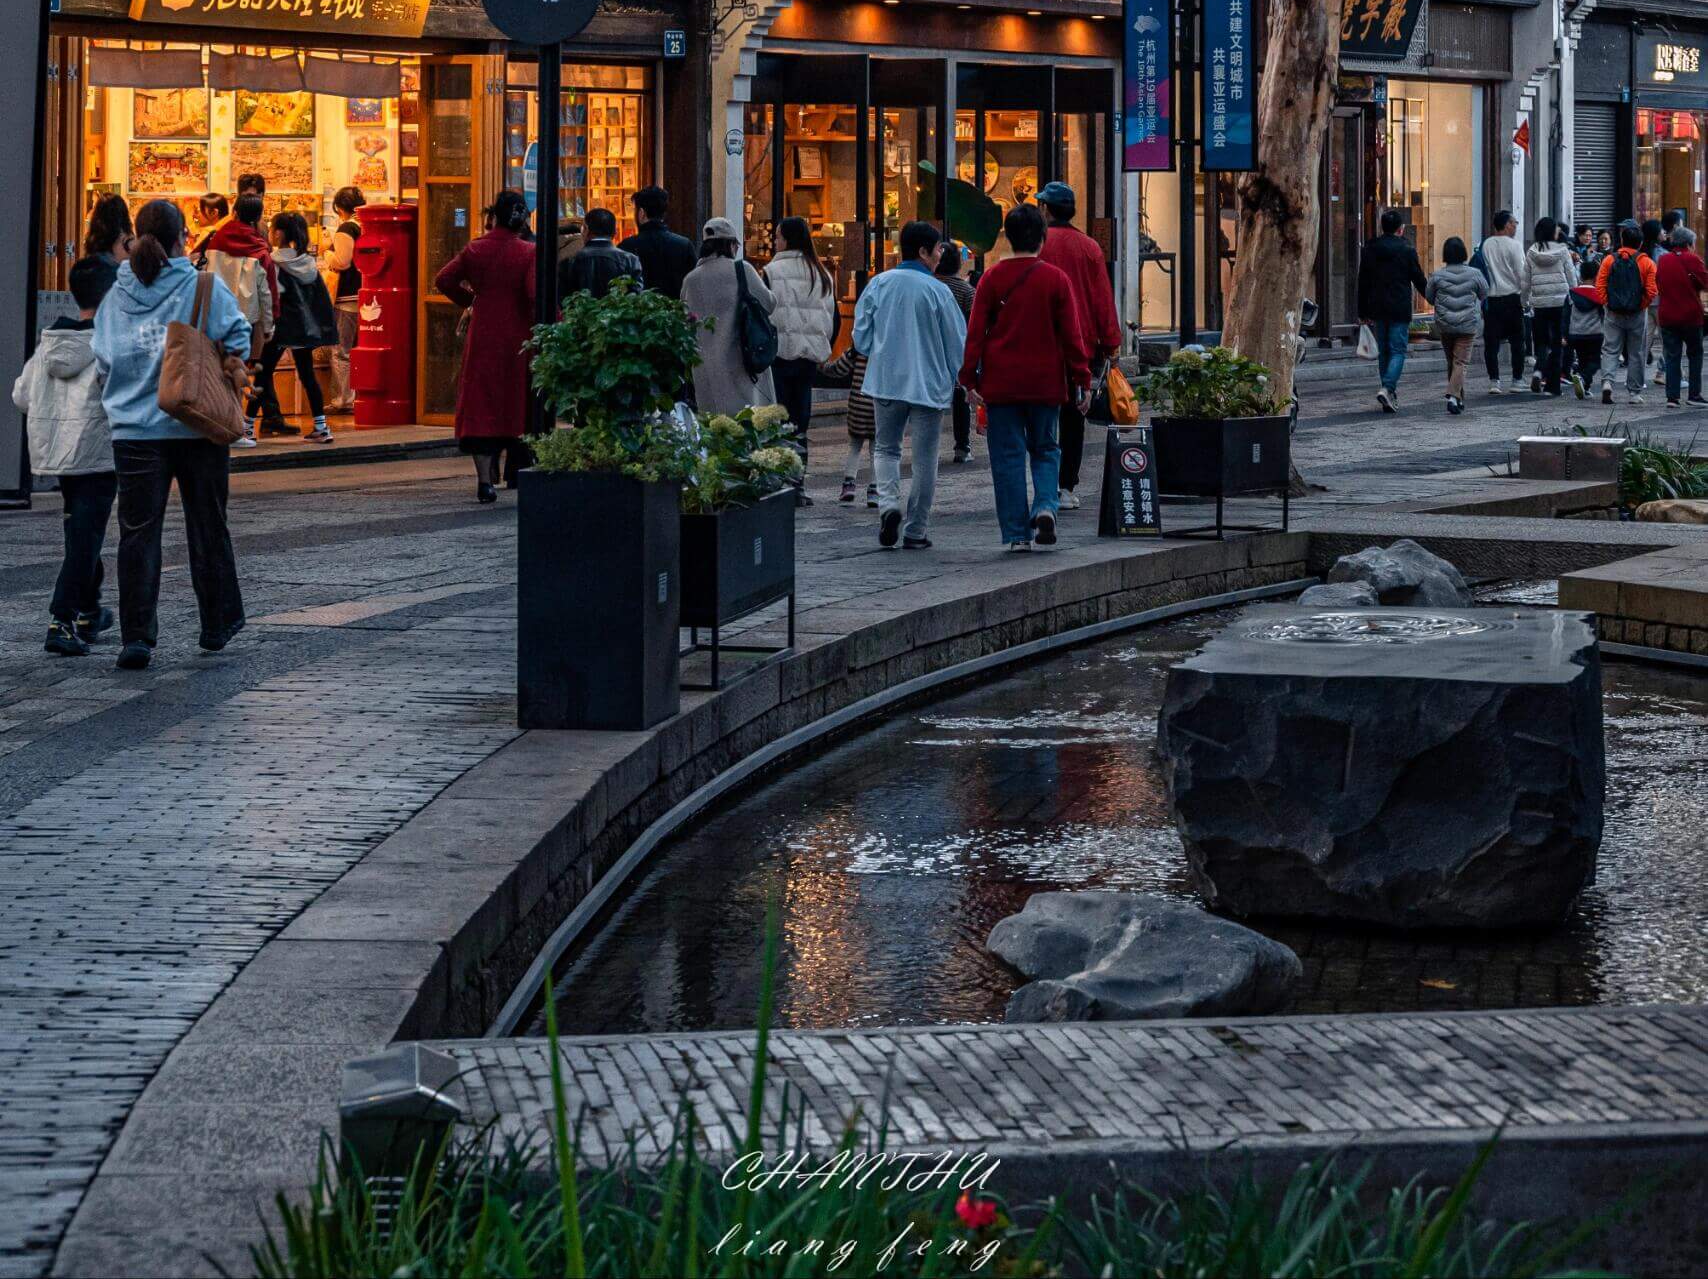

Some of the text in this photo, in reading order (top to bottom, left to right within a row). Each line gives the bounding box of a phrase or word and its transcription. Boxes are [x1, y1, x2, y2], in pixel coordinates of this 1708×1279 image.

[1229, 0, 1243, 100] 共建文明城市
[1212, 47, 1226, 148] 共襄亚运盛会
[1121, 478, 1137, 525] 注意安全
[1139, 478, 1154, 525] 请勿嬉水
